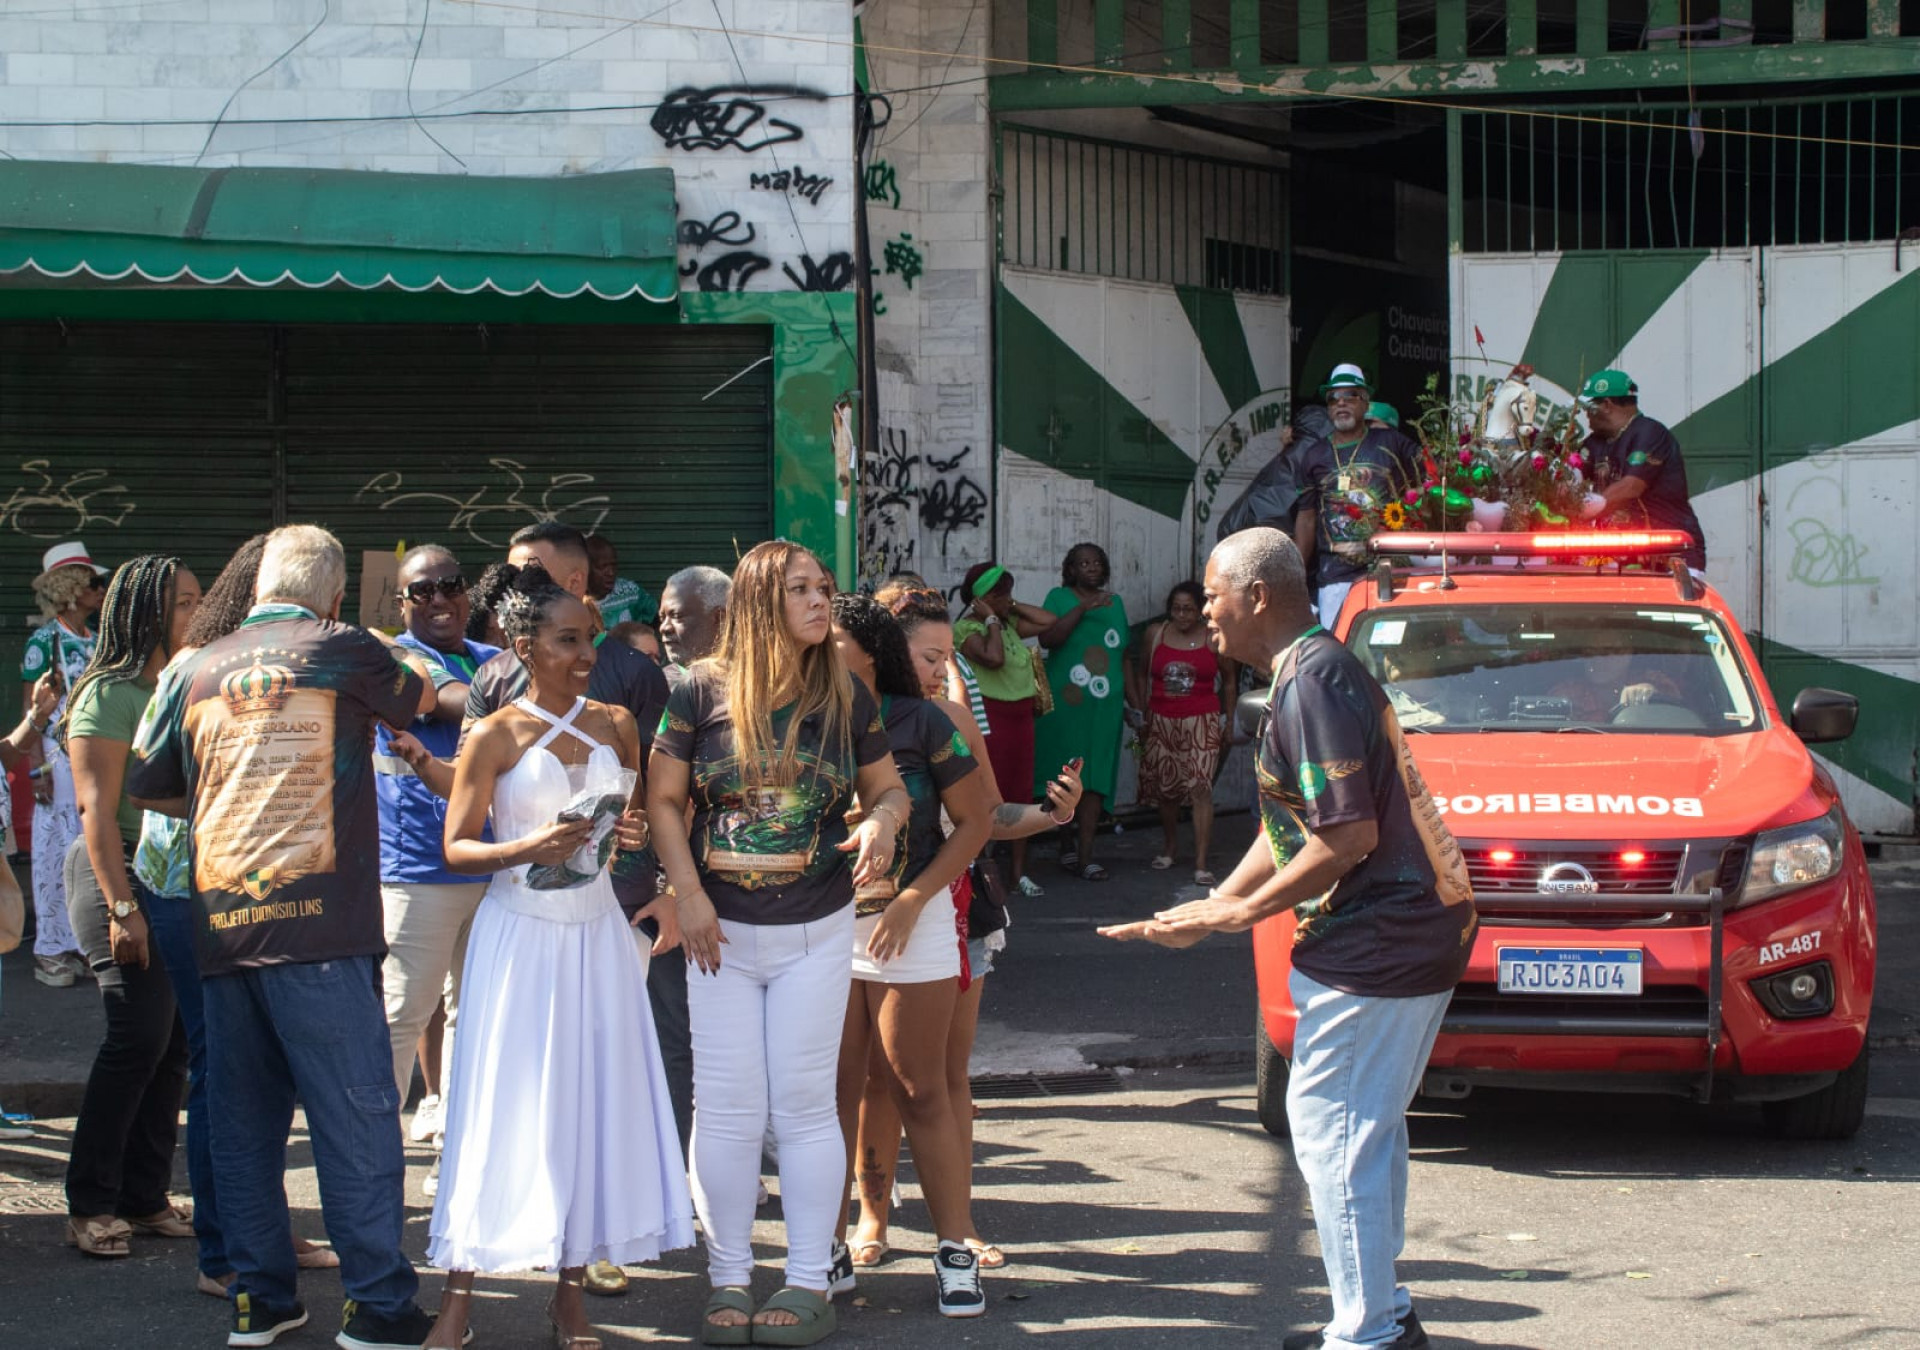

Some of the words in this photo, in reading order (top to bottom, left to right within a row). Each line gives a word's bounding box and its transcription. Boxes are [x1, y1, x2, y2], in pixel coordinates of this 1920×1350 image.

[1545, 883, 1594, 892] NISSAN
[209, 907, 250, 932] PROJETO
[251, 901, 297, 924] DIONÍSIO
[299, 898, 323, 917] LINS
[1558, 953, 1582, 961] BRASIL
[1759, 930, 1822, 965] AR-487
[1511, 962, 1625, 989] RJC3A04
